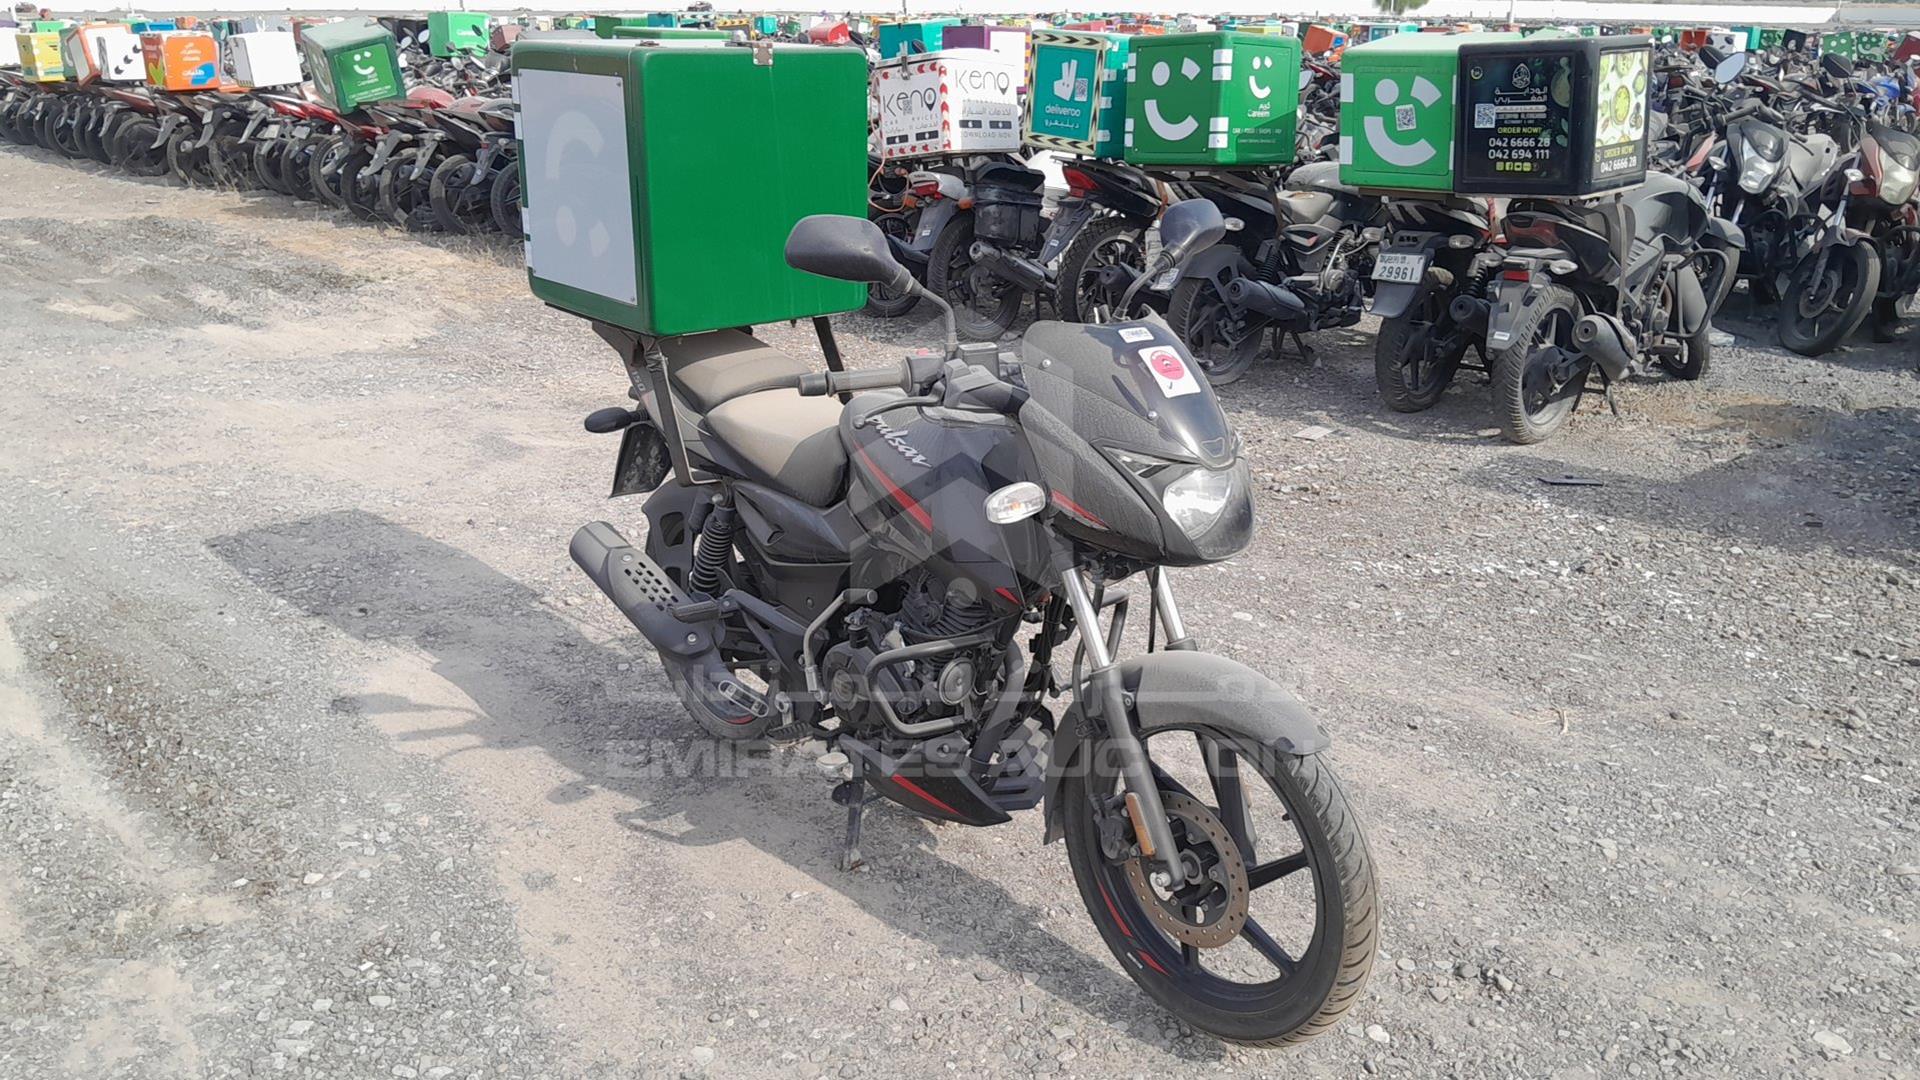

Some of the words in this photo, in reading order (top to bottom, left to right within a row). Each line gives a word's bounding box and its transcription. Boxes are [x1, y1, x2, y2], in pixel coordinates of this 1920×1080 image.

[1045, 104, 1081, 117] deliveroo
[1488, 137, 1508, 147] 042
[1510, 137, 1536, 147] 6666
[1537, 137, 1551, 147] 28
[1488, 149, 1509, 159] 042
[1511, 149, 1532, 159] 694
[1535, 149, 1550, 159] 111
[1600, 160, 1613, 173] 042
[1378, 265, 1415, 281] 29961
